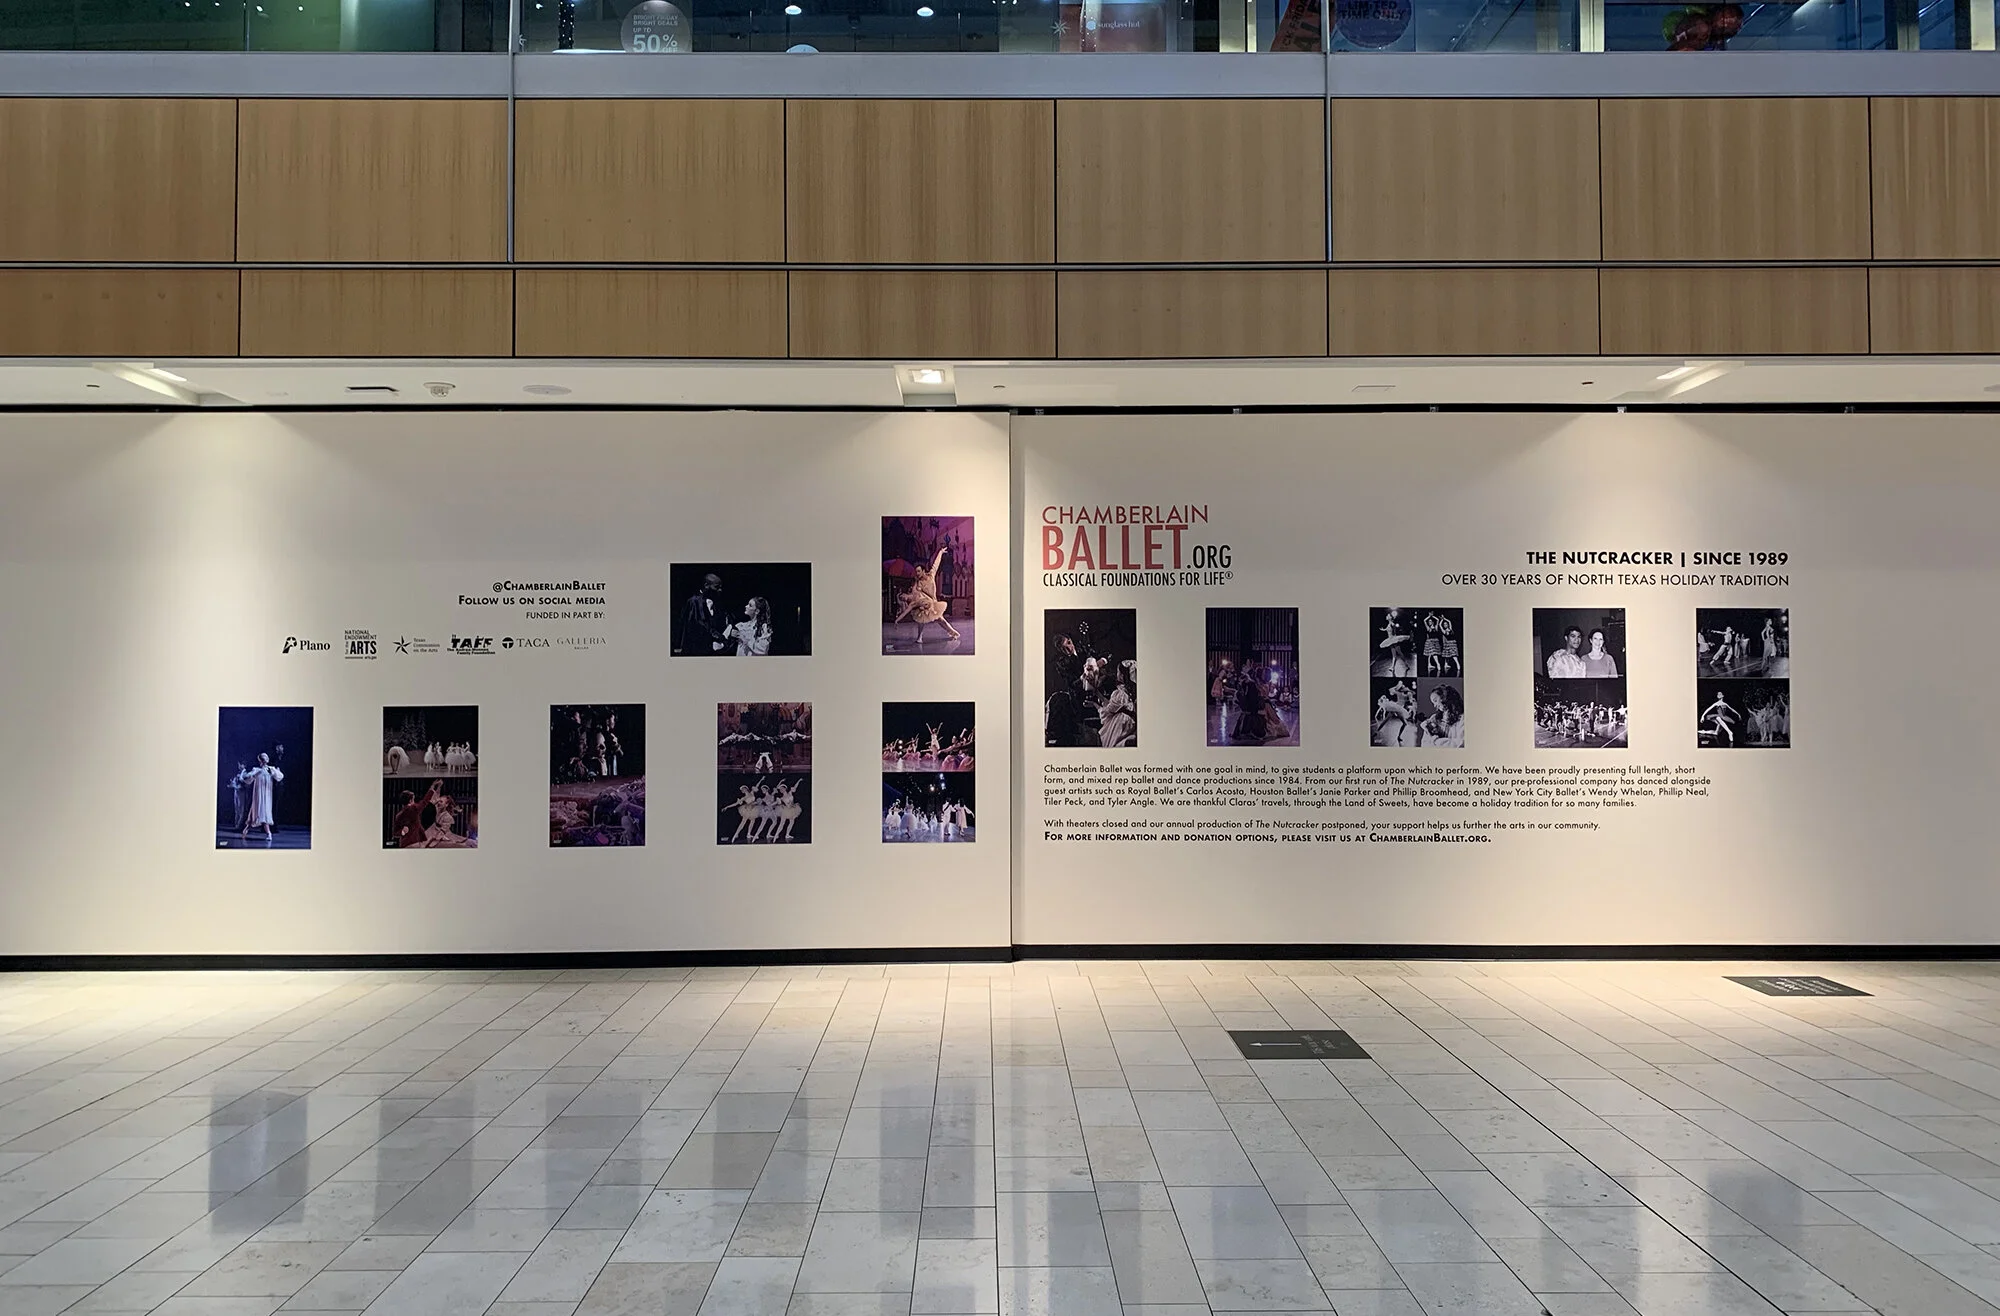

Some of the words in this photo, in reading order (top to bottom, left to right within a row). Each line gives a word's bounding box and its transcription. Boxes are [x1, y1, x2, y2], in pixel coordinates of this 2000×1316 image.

[633, 34, 678, 52] 50%
[1042, 505, 1208, 524] CHAMBERLAIN
[1042, 524, 1232, 570] BALLET.ORG
[1526, 552, 1556, 566] THE
[1562, 552, 1673, 566] NUTCRACKER
[1693, 552, 1741, 566] SINCE
[1748, 552, 1788, 566] 1989
[1043, 573, 1098, 587] CLASSICAL
[1101, 572, 1176, 586] FOUNDATIONS
[1180, 572, 1200, 586] FOR
[1442, 574, 1476, 586] OVER
[1481, 574, 1497, 586] 30
[1501, 574, 1541, 586] YEARS
[1545, 574, 1563, 586] OF
[1568, 575, 1613, 586] NORTH
[1618, 575, 1656, 586] TEXAS
[1660, 575, 1716, 586] HOLIDAY
[1720, 575, 1788, 586] TRADITION
[492, 580, 606, 593] @CHAMBERLAINBALLET
[458, 595, 499, 604] FOLLOW
[526, 612, 559, 620] FUNDED
[561, 612, 570, 620] IN
[572, 612, 591, 620] PART
[594, 612, 604, 620] BY:
[300, 640, 331, 651] Plano
[350, 641, 377, 654] ARTS
[451, 638, 494, 648] TAFF
[516, 638, 550, 647] TACA
[1044, 764, 1096, 773] Chamberlain
[1099, 764, 1122, 773] Ballet
[1144, 764, 1173, 773] formed
[1175, 764, 1193, 773] with
[1214, 764, 1232, 776] goal
[1245, 764, 1268, 776] mind,
[1282, 764, 1299, 776] give
[1302, 764, 1335, 773] students
[1346, 764, 1381, 776] platform
[1384, 767, 1405, 776] upon
[1408, 765, 1432, 773] which
[1446, 765, 1482, 776] perform.
[1502, 765, 1522, 774] have
[1524, 765, 1546, 774] been
[1548, 765, 1580, 776] proudly
[1583, 765, 1626, 776] presenting
[1628, 765, 1641, 774] full
[1643, 765, 1671, 776] length,
[1674, 765, 1695, 774] short
[1044, 775, 1065, 786] form,
[1087, 775, 1112, 784] mixed
[1131, 775, 1154, 784] ballet
[1175, 775, 1200, 784] dance
[1203, 775, 1252, 786] productions
[1254, 775, 1274, 784] since
[1278, 775, 1302, 784] 1984.
[1305, 775, 1326, 784] From
[1345, 775, 1360, 784] first
[1390, 776, 1405, 784] The
[1408, 776, 1454, 784] Nutcracker
[1468, 776, 1491, 787] 1989,
[1510, 776, 1577, 787] pre-professional
[1579, 779, 1618, 787] company
[1637, 776, 1668, 785] danced
[1670, 776, 1710, 787] alongside
[1044, 786, 1066, 797] guest
[1068, 786, 1092, 795] artists
[1094, 786, 1113, 795] such
[1127, 786, 1150, 797] Royal
[1153, 786, 1183, 795] Ballet's
[1186, 786, 1213, 795] Carlos
[1215, 786, 1246, 797] Acosta,
[1250, 786, 1284, 795] Houston
[1286, 786, 1316, 795] Ballet's
[1319, 786, 1341, 795] Janie
[1344, 786, 1370, 795] Parker
[1392, 787, 1417, 798] Phillip
[1420, 787, 1470, 798] Broomhead,
[1492, 787, 1512, 796] New
[1515, 787, 1534, 796] York
[1536, 787, 1553, 798] City
[1555, 787, 1586, 796] Ballet's
[1588, 787, 1618, 798] Wendy
[1620, 787, 1655, 798] Whelan,
[1658, 787, 1683, 798] Phillip
[1686, 787, 1708, 798] Neal,
[1044, 797, 1061, 806] Tiler
[1064, 797, 1086, 808] Peck,
[1108, 797, 1127, 808] Tyler
[1129, 797, 1156, 808] Angle.
[1193, 797, 1226, 806] thankful
[1228, 797, 1258, 806] Claras'
[1261, 797, 1290, 808] travels,
[1294, 797, 1326, 809] through
[1344, 798, 1364, 806] Land
[1378, 798, 1410, 809] Sweets,
[1413, 798, 1433, 806] have
[1436, 798, 1469, 806] become
[1480, 798, 1511, 809] holiday
[1514, 798, 1548, 807] tradition
[1577, 801, 1600, 809] many
[1602, 798, 1636, 807] families.
[1044, 819, 1064, 827] With
[1066, 819, 1099, 827] theaters
[1101, 819, 1128, 828] closed
[1166, 819, 1194, 828] annual
[1197, 819, 1241, 830] production
[1256, 819, 1270, 828] The
[1272, 819, 1319, 828] Nutcracker
[1321, 820, 1368, 831] postponed,
[1370, 822, 1390, 831] your
[1393, 820, 1424, 831] support
[1427, 820, 1449, 831] helps
[1463, 820, 1491, 828] further
[1509, 820, 1525, 829] arts
[1554, 820, 1600, 831] community.
[1044, 832, 1062, 841] FOR
[1095, 832, 1157, 841] INFORMATION
[1160, 832, 1180, 841] AND
[1184, 832, 1231, 841] DONATION
[1235, 832, 1277, 844] OPTIONS,
[1282, 832, 1311, 842] PLEASE
[1314, 833, 1336, 842] VISIT
[1369, 833, 1491, 842] CHAMBERLAINBALLET.ORG.
